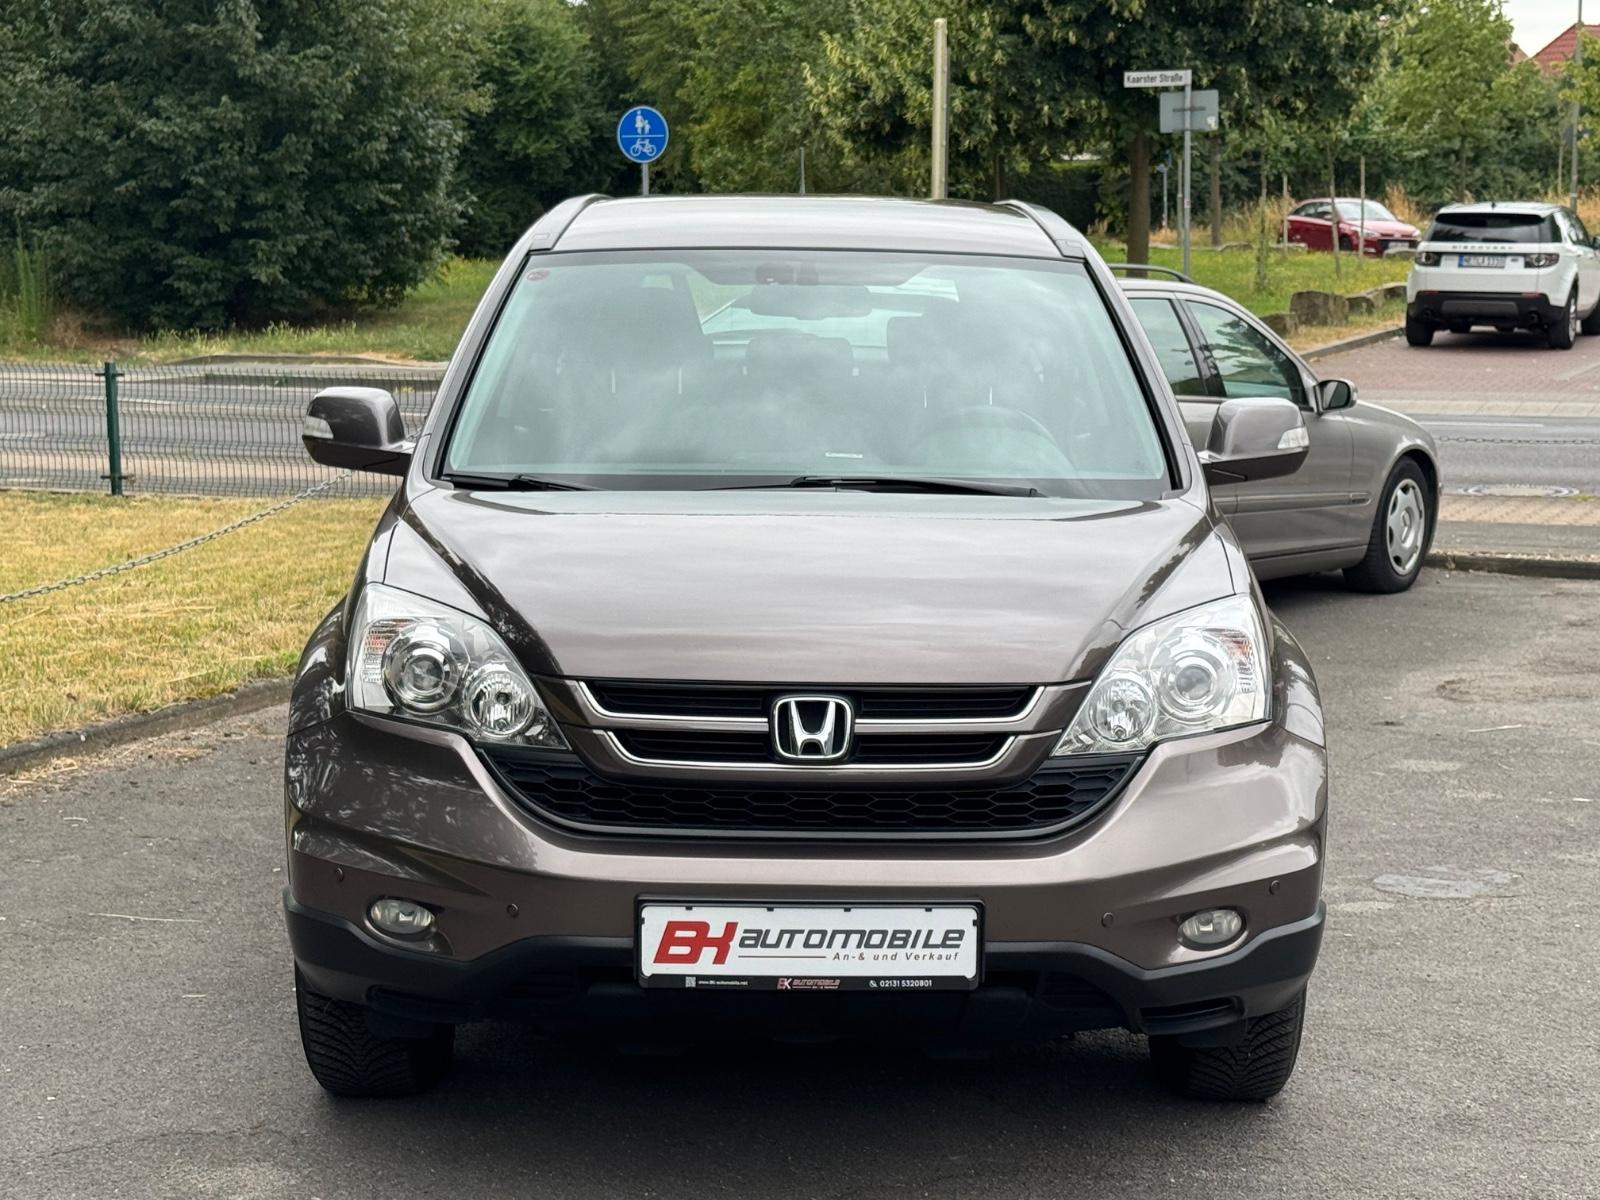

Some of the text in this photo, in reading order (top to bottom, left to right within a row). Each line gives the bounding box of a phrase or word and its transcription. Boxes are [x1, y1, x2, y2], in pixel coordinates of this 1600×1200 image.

[1127, 73, 1183, 84] Kaarster Straße
[652, 920, 739, 965] BK
[873, 951, 898, 961] und
[905, 951, 960, 961] Verkauf
[879, 980, 933, 988] 02131 5320801
